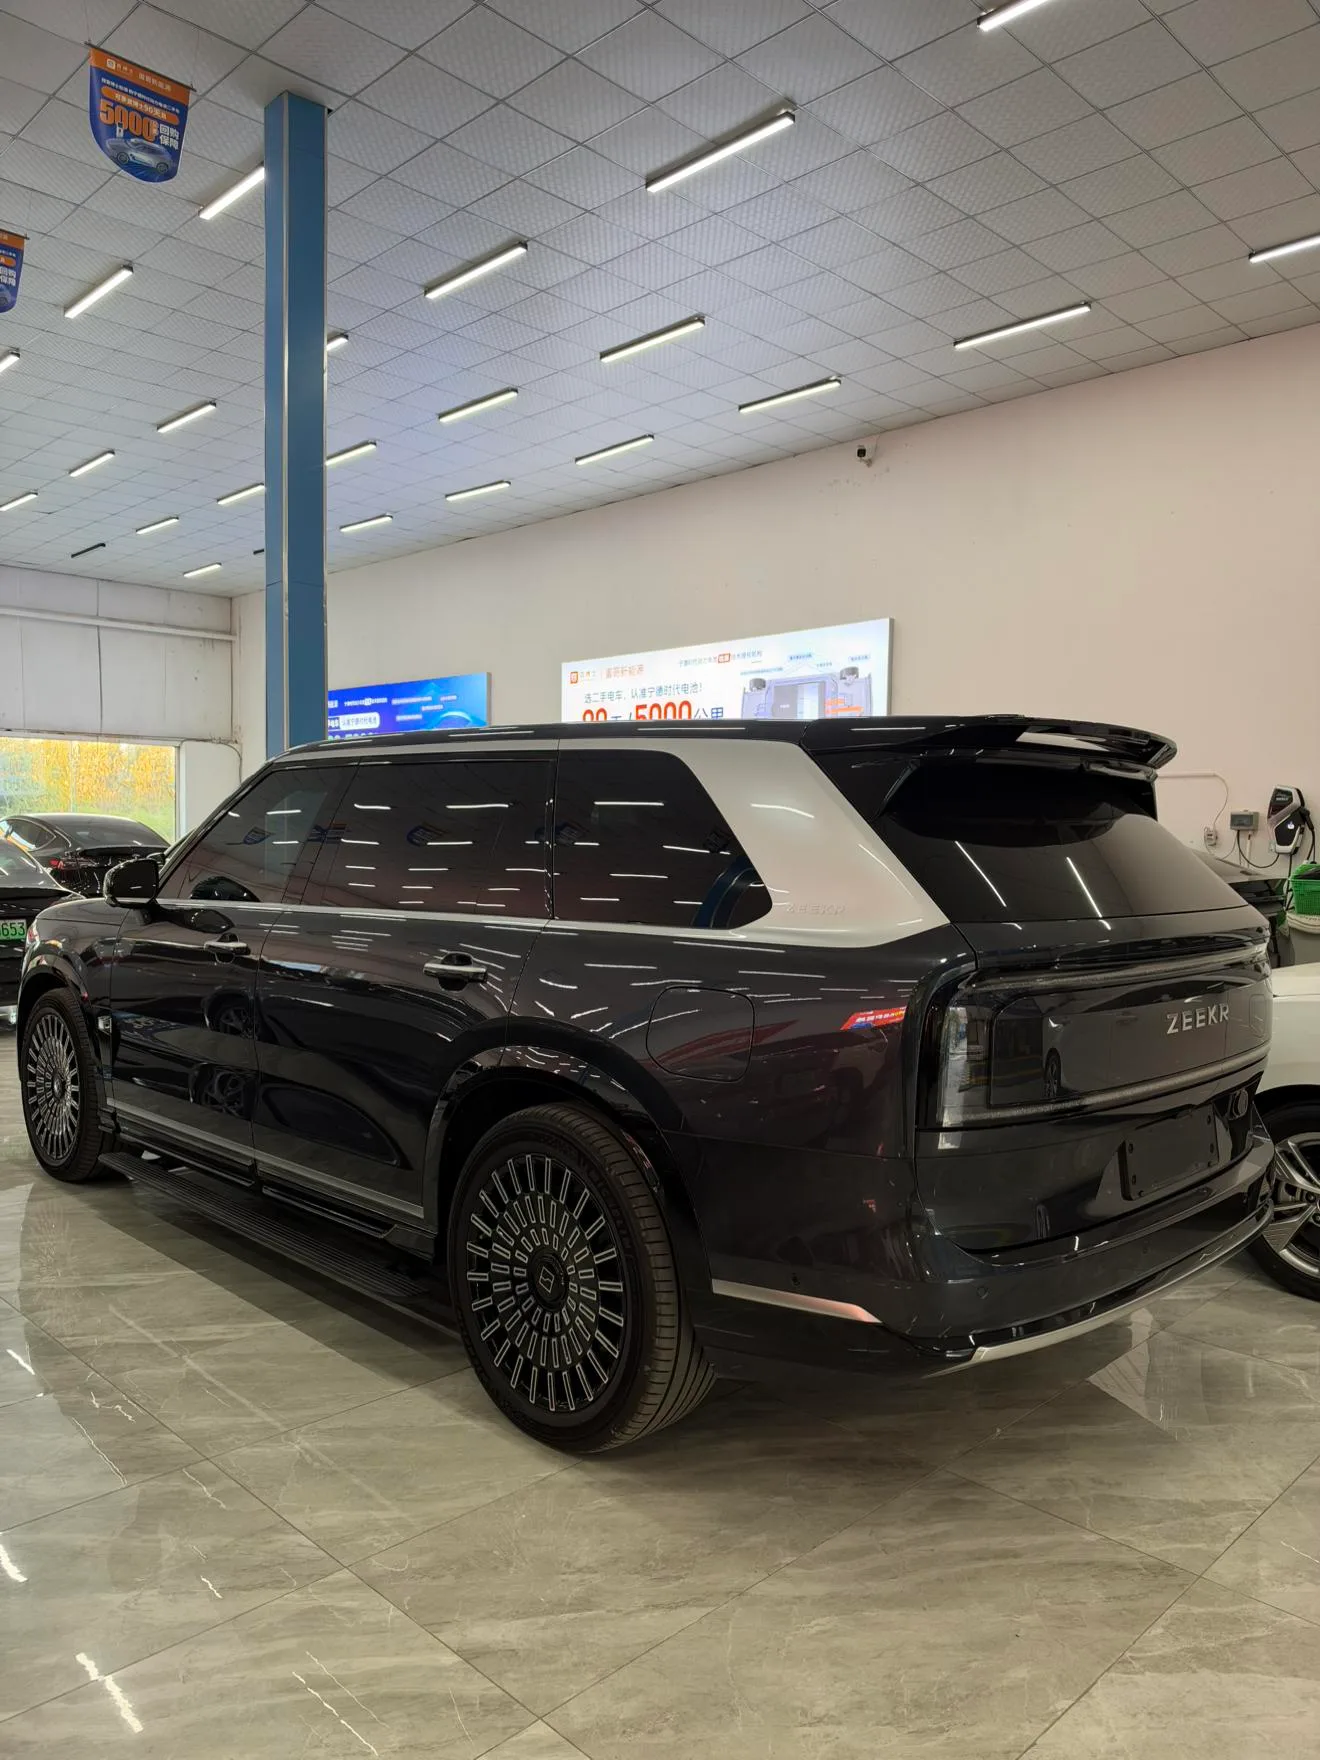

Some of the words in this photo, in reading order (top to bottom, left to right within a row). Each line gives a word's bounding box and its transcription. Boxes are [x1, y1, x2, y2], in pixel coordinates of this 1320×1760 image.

[99, 98, 157, 143] 5000
[0, 922, 26, 937] 653
[1166, 1003, 1229, 1035] ZEEKR
